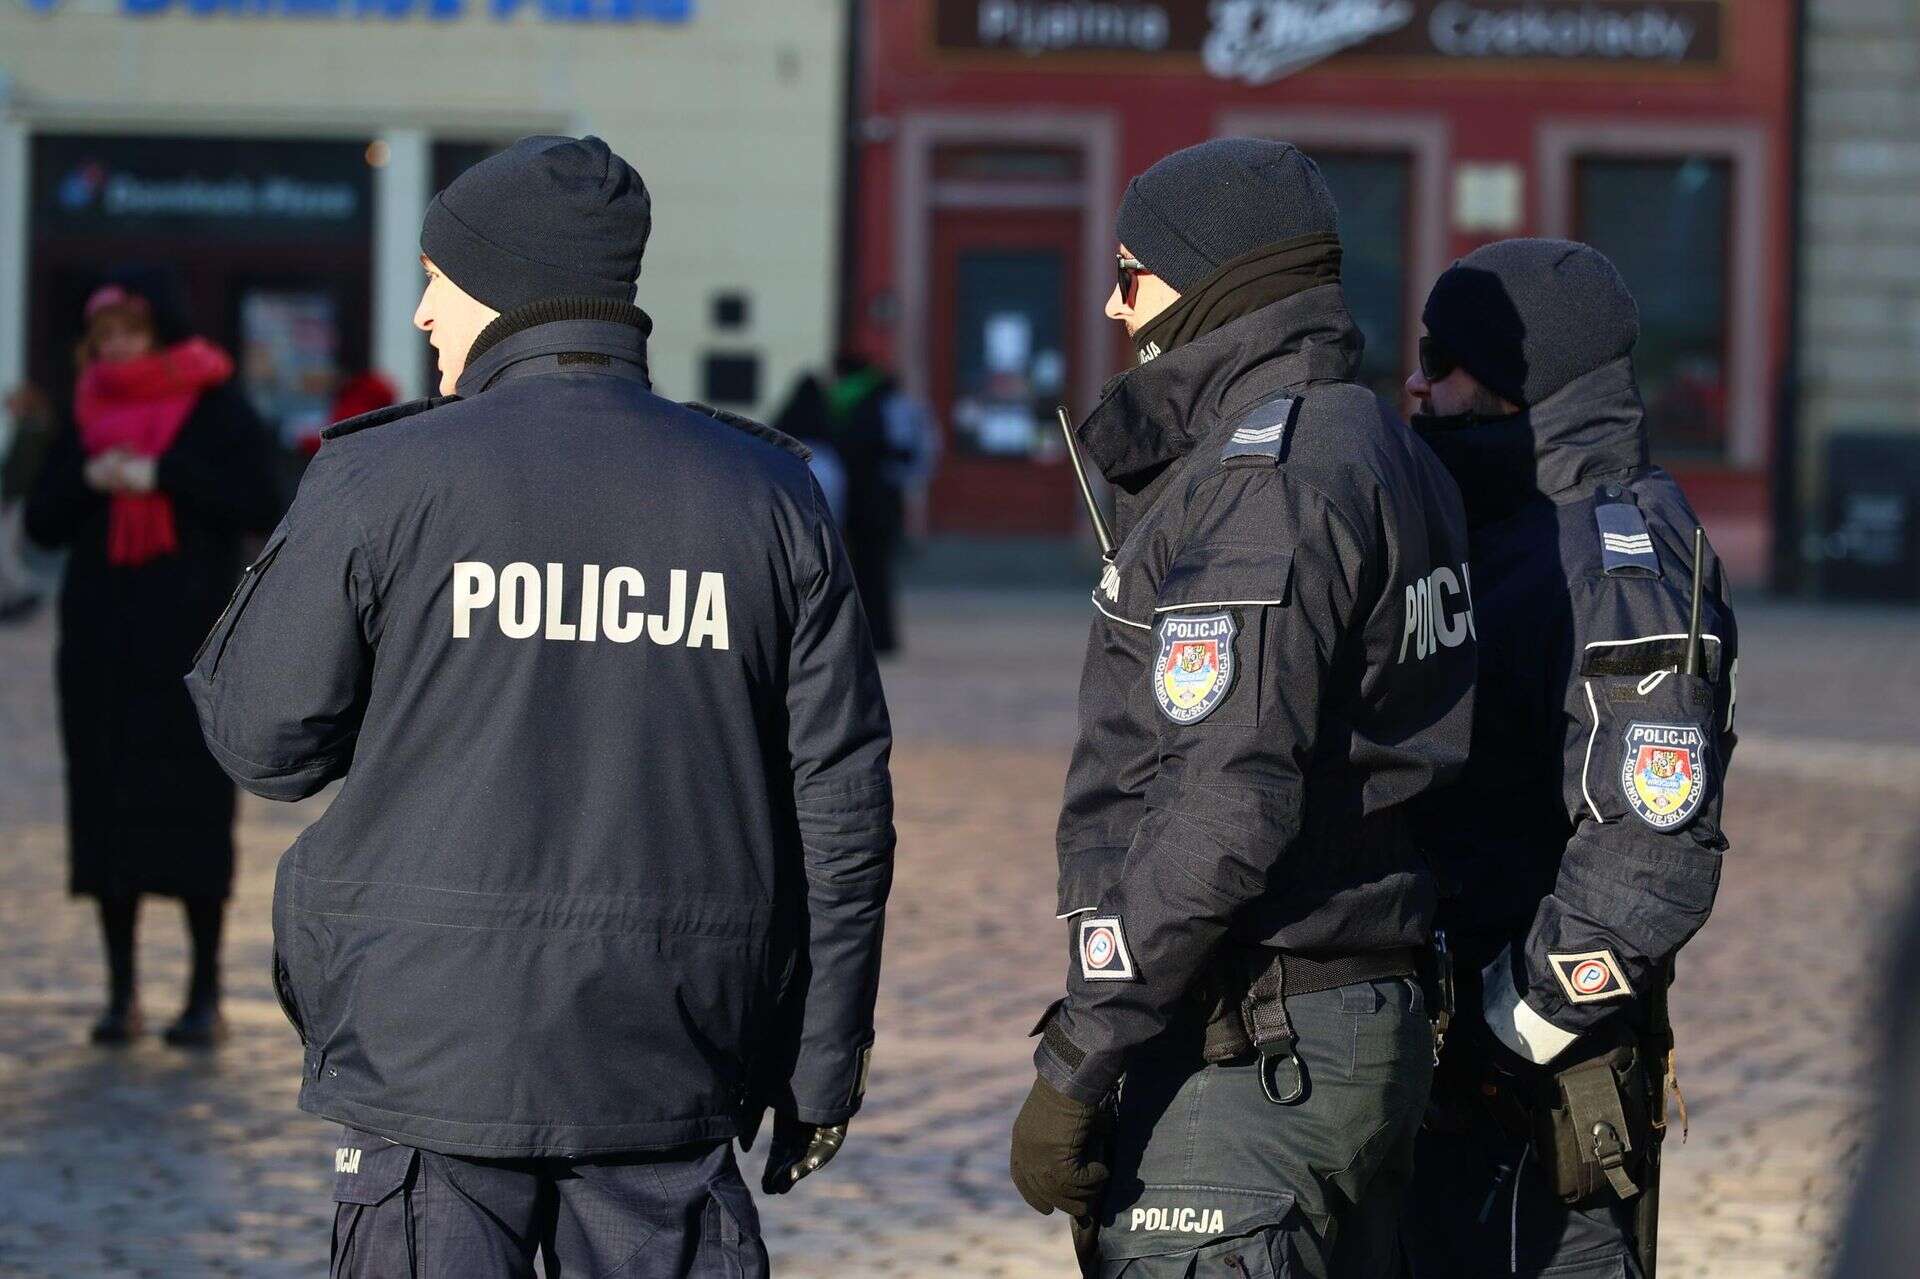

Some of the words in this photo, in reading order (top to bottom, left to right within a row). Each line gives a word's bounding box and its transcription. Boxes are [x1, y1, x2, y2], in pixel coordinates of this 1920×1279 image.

[453, 561, 729, 650] POLICJA
[1166, 620, 1228, 638] POLICJA
[1171, 699, 1210, 719] MIEJSKA
[1212, 652, 1228, 693] POLICJI
[1633, 728, 1698, 744] POLICJA
[1625, 758, 1641, 808] KOMENDA
[1644, 808, 1686, 824] MIEJSKA
[1687, 763, 1700, 804] POLICJI
[1130, 1207, 1225, 1234] POLICJA
